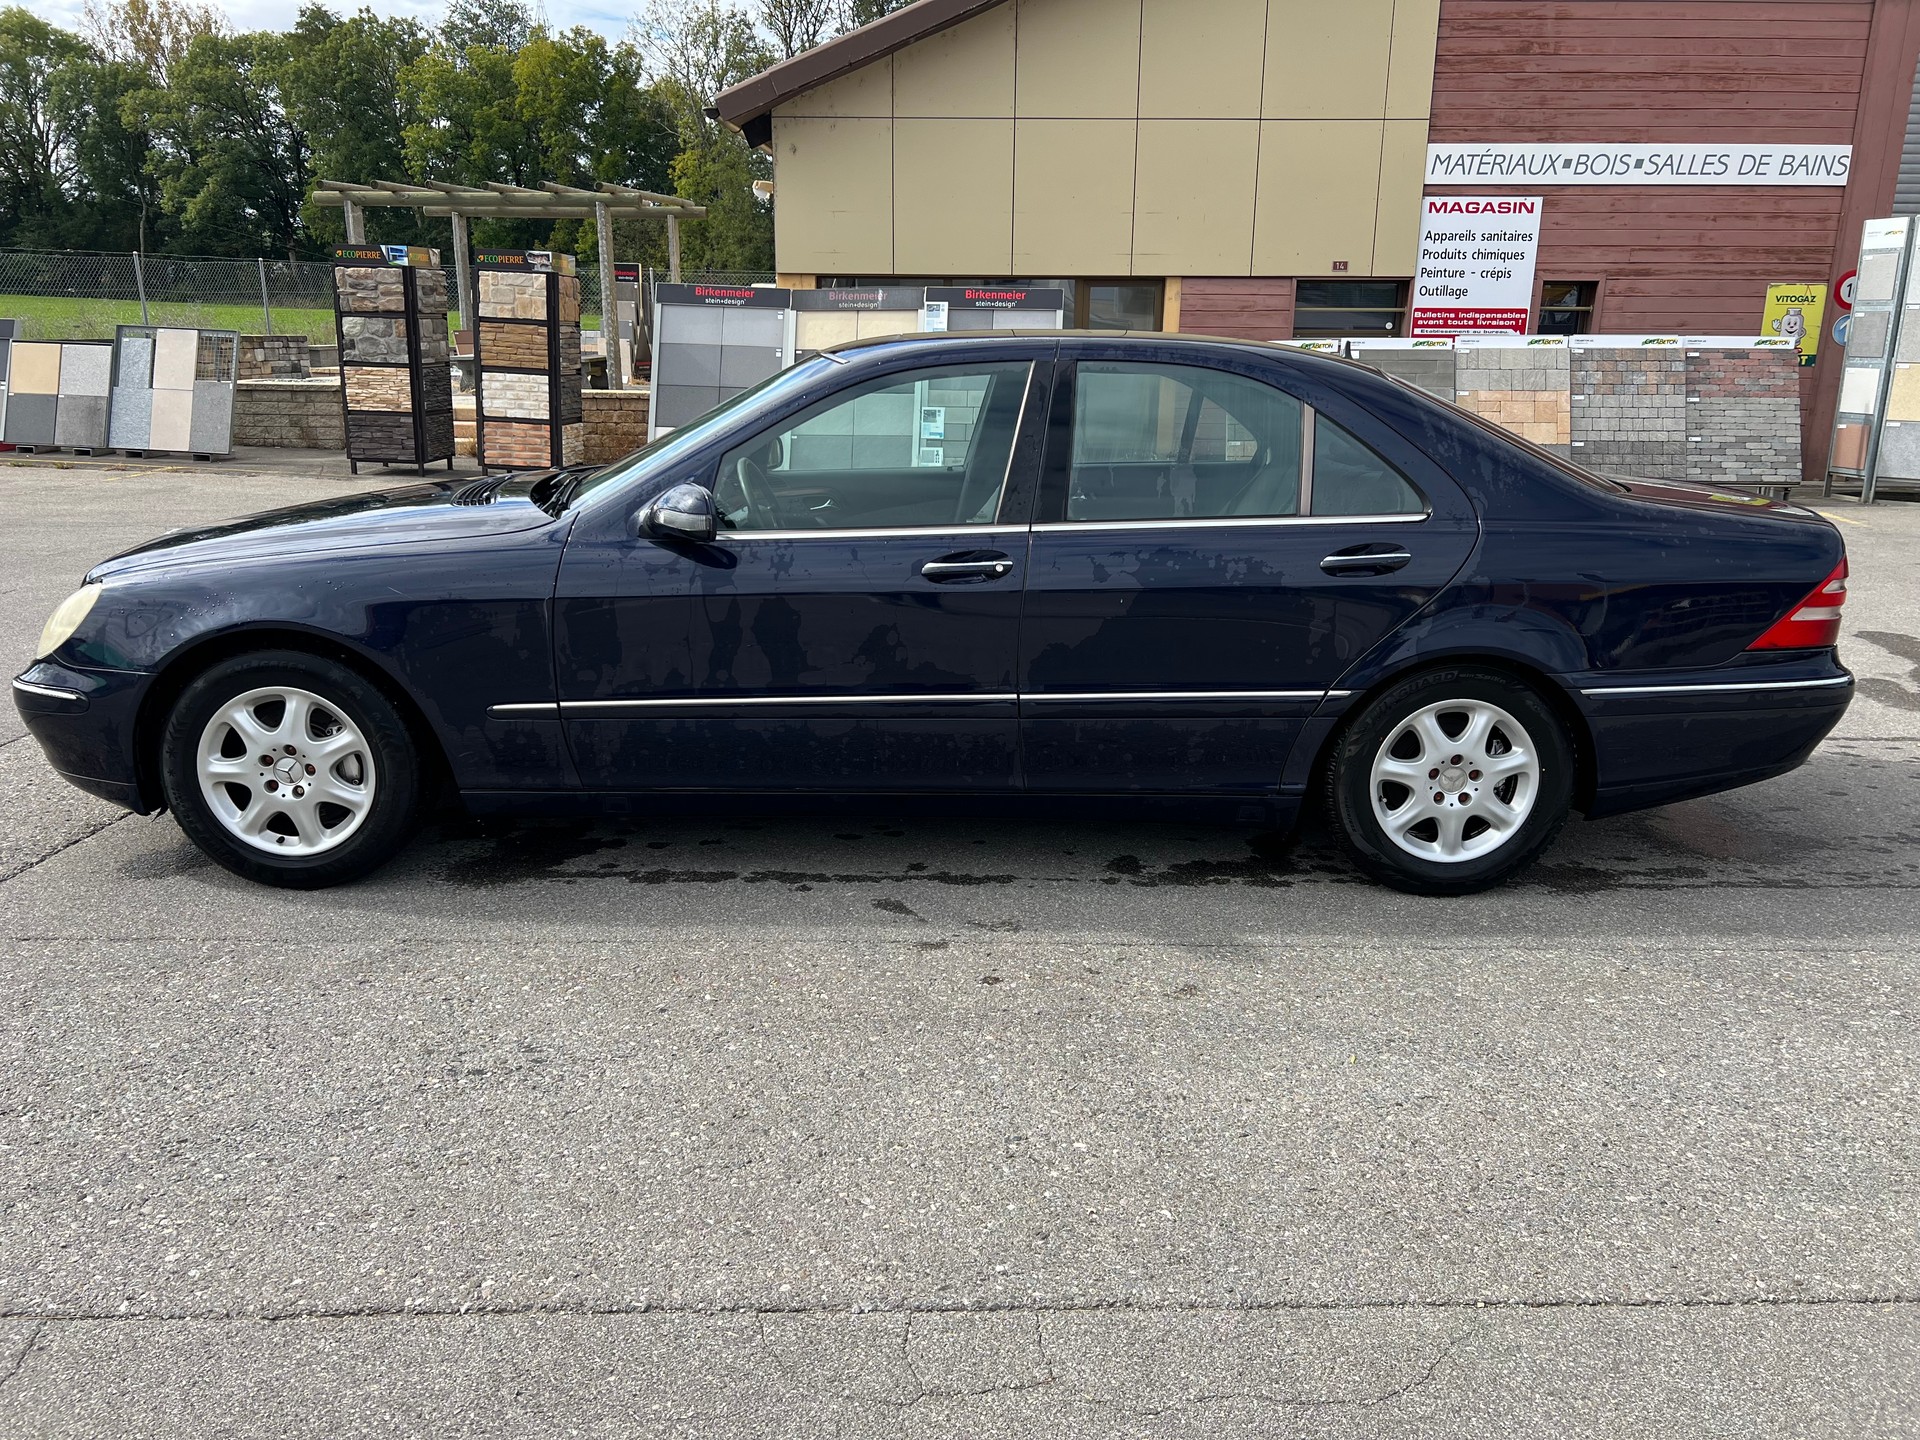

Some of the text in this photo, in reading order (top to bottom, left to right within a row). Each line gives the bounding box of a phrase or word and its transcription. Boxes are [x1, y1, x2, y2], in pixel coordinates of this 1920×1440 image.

[1430, 149, 1850, 176] MATÉRIAUX BOIS SALLES DE BAINS
[1428, 202, 1535, 214] MAGASIN
[1424, 230, 1533, 244] Appareils sanitaires
[342, 250, 381, 259] ECOPIERRE
[484, 255, 524, 264] ECOPIERRE
[1422, 248, 1525, 263] Produits chimiques
[1420, 267, 1465, 278] Peinture
[1480, 267, 1512, 281] crépis
[695, 287, 755, 298] Birkenmeier
[828, 291, 888, 301] Birkenmeier
[965, 289, 1026, 300] Birkenmeier
[1419, 285, 1468, 299] Outillage
[1775, 295, 1817, 303] VITOGAZ
[1458, 311, 1526, 319] indispensables
